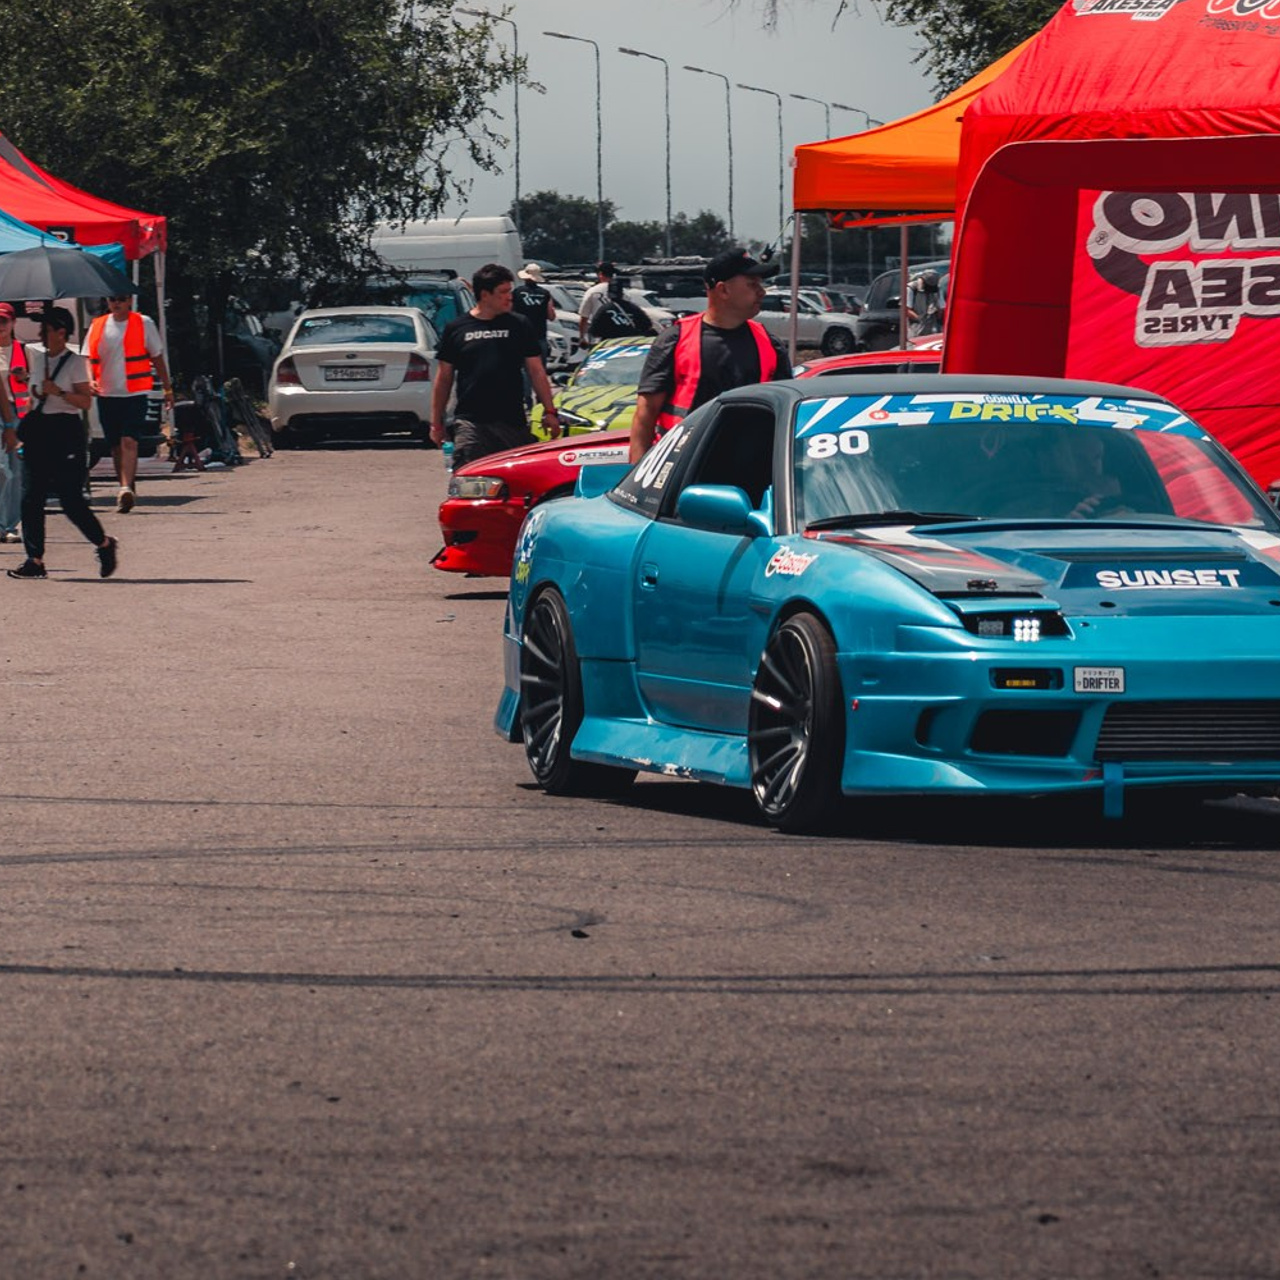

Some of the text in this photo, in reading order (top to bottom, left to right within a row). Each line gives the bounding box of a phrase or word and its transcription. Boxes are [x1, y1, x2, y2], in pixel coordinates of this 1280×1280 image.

[465, 330, 509, 340] DUCATI
[983, 394, 1031, 405] GORILLA
[807, 430, 869, 458] 80
[634, 423, 684, 488] 80
[1096, 569, 1240, 588] SUNSET
[1083, 677, 1120, 689] DRIFTER
